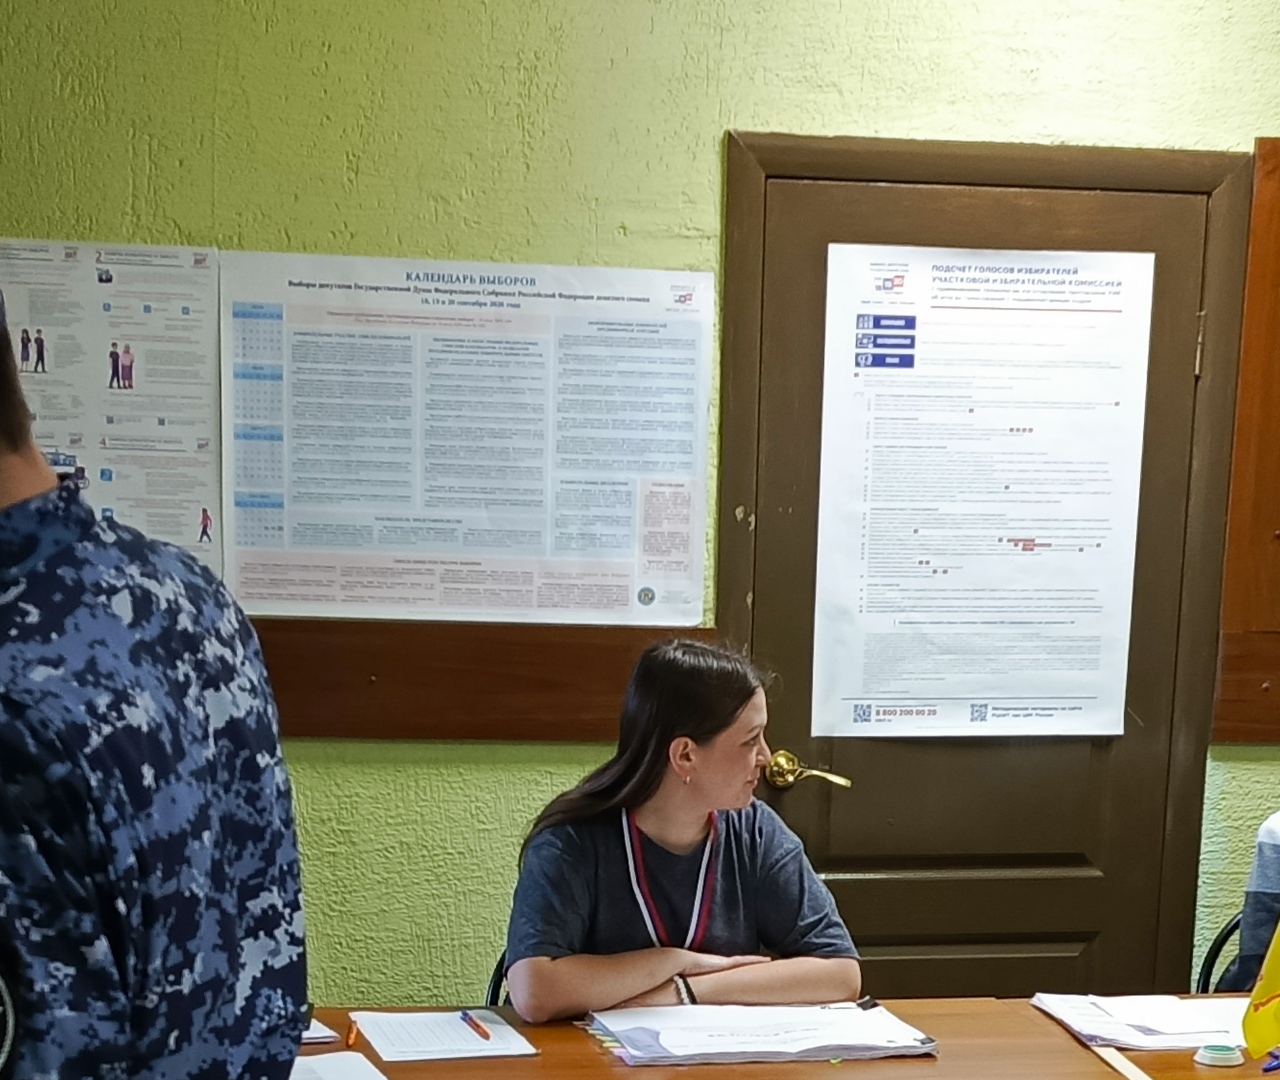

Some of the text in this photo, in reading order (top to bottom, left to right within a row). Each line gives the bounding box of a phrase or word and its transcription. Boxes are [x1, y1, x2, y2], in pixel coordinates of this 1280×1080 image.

[974, 266, 1015, 274] ГОЛОСОВ
[1017, 266, 1079, 275] ИЗБИРАТЕЛЕЙ
[405, 271, 536, 287] КАЛЕНДАРЬ ВЫБОРОВ
[931, 275, 1122, 287] УЧАСТКОВОЙ ИЗБИРАТЕЛЬНОЙ КОМИССИЕЙ
